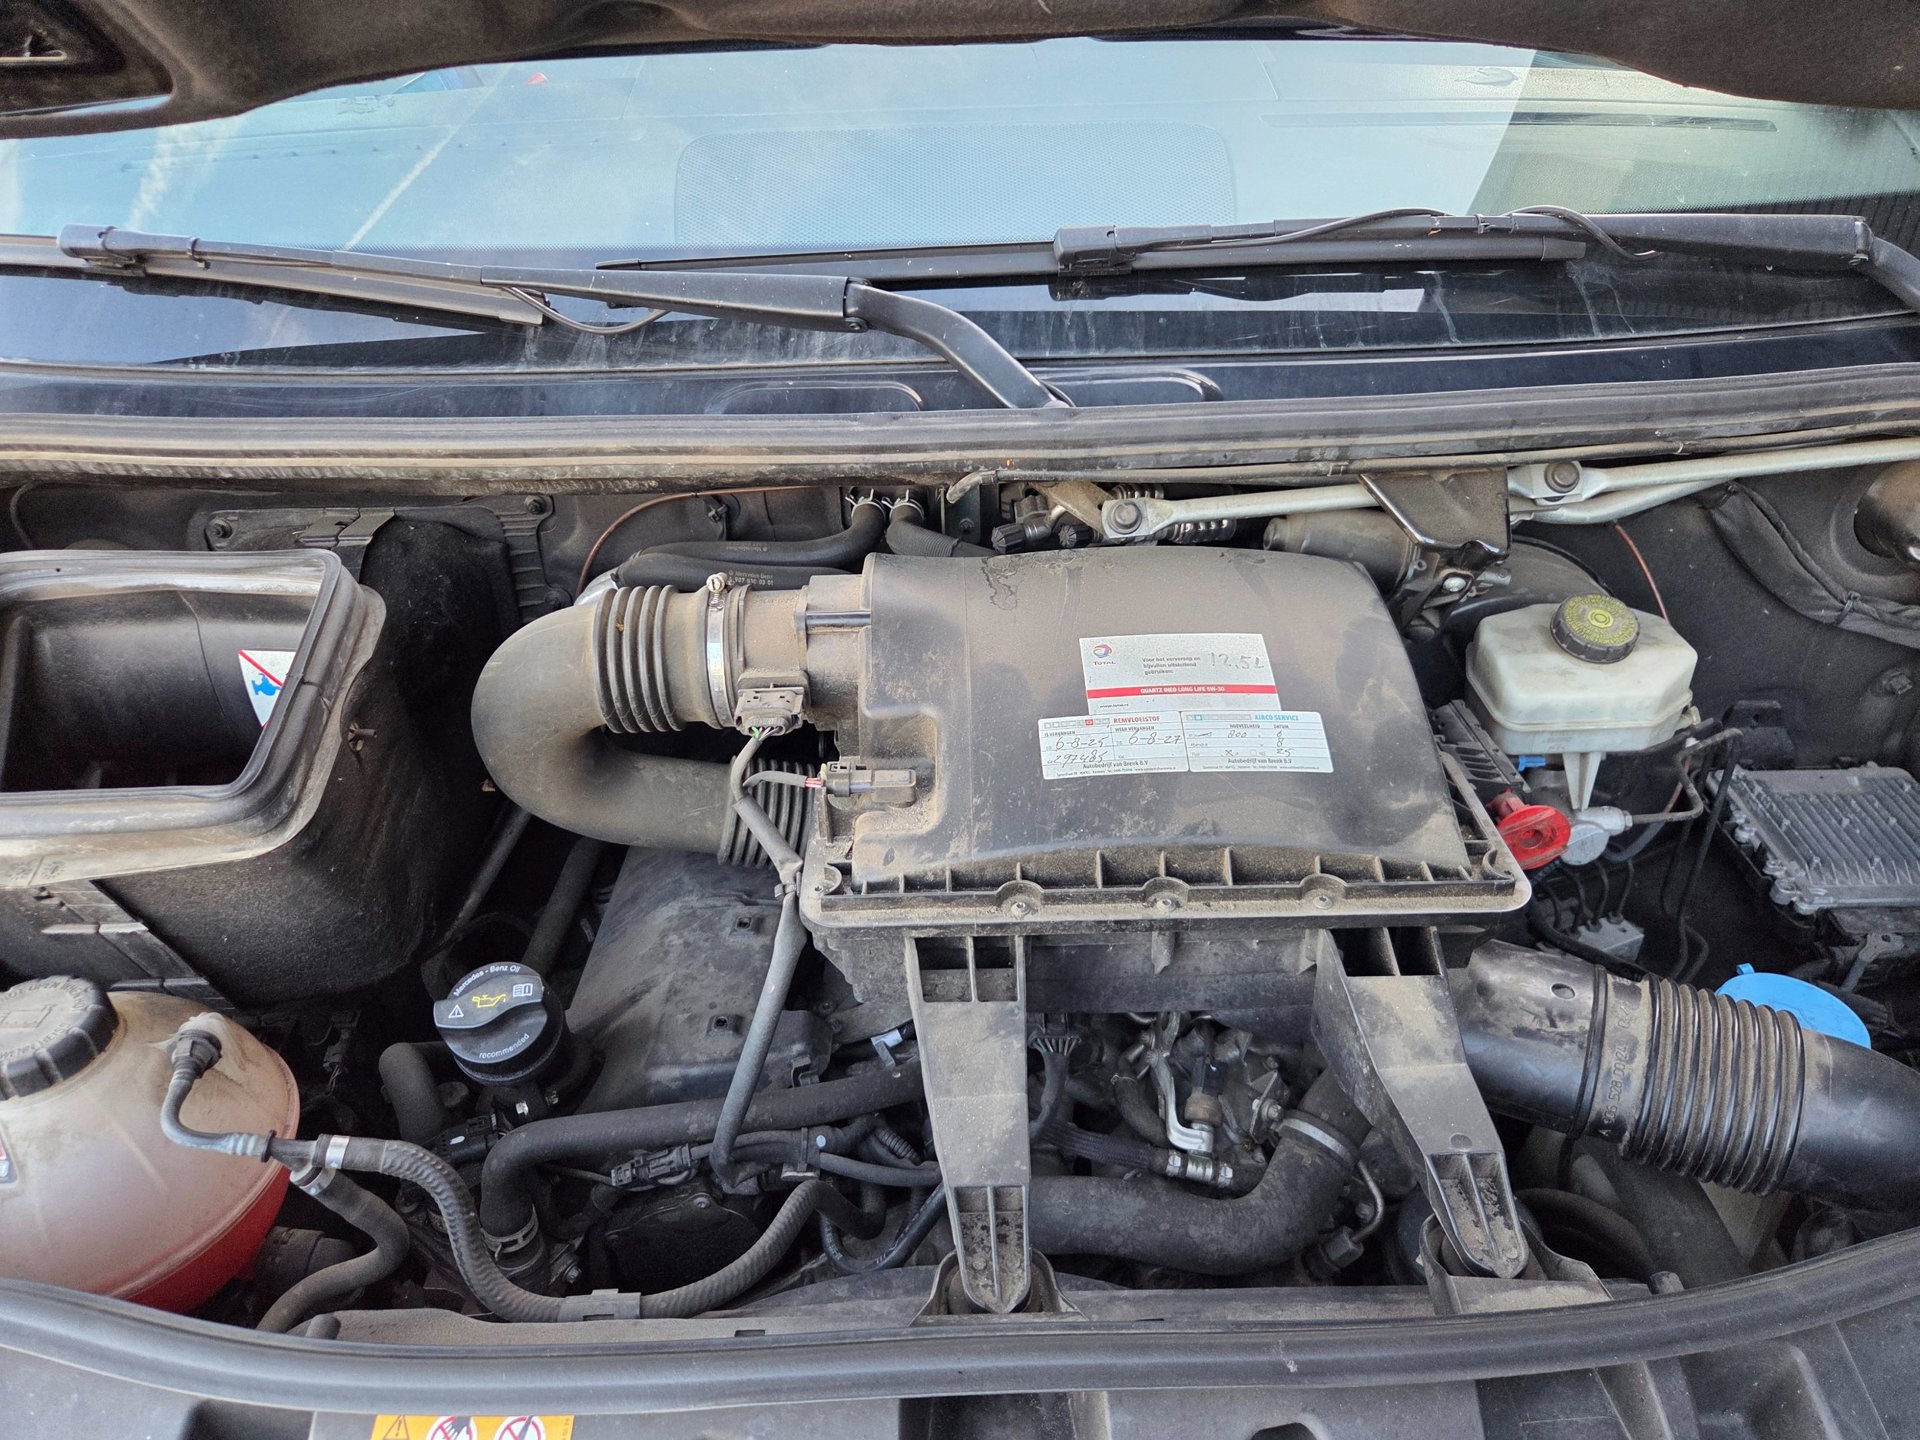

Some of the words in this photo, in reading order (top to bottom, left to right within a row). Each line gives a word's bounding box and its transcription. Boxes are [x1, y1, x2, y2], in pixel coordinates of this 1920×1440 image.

[1113, 716, 1160, 724] REMVLOEISTOF
[1055, 734, 1109, 751] 6-8-25
[1128, 729, 1182, 745] 6-8-27
[1083, 761, 1112, 769] Autobedrijf
[453, 969, 484, 997] Mercedes
[490, 965, 508, 973] Benz
[509, 965, 521, 973] Oil
[479, 1033, 530, 1059] recommended
[1608, 1080, 1623, 1101] 528
